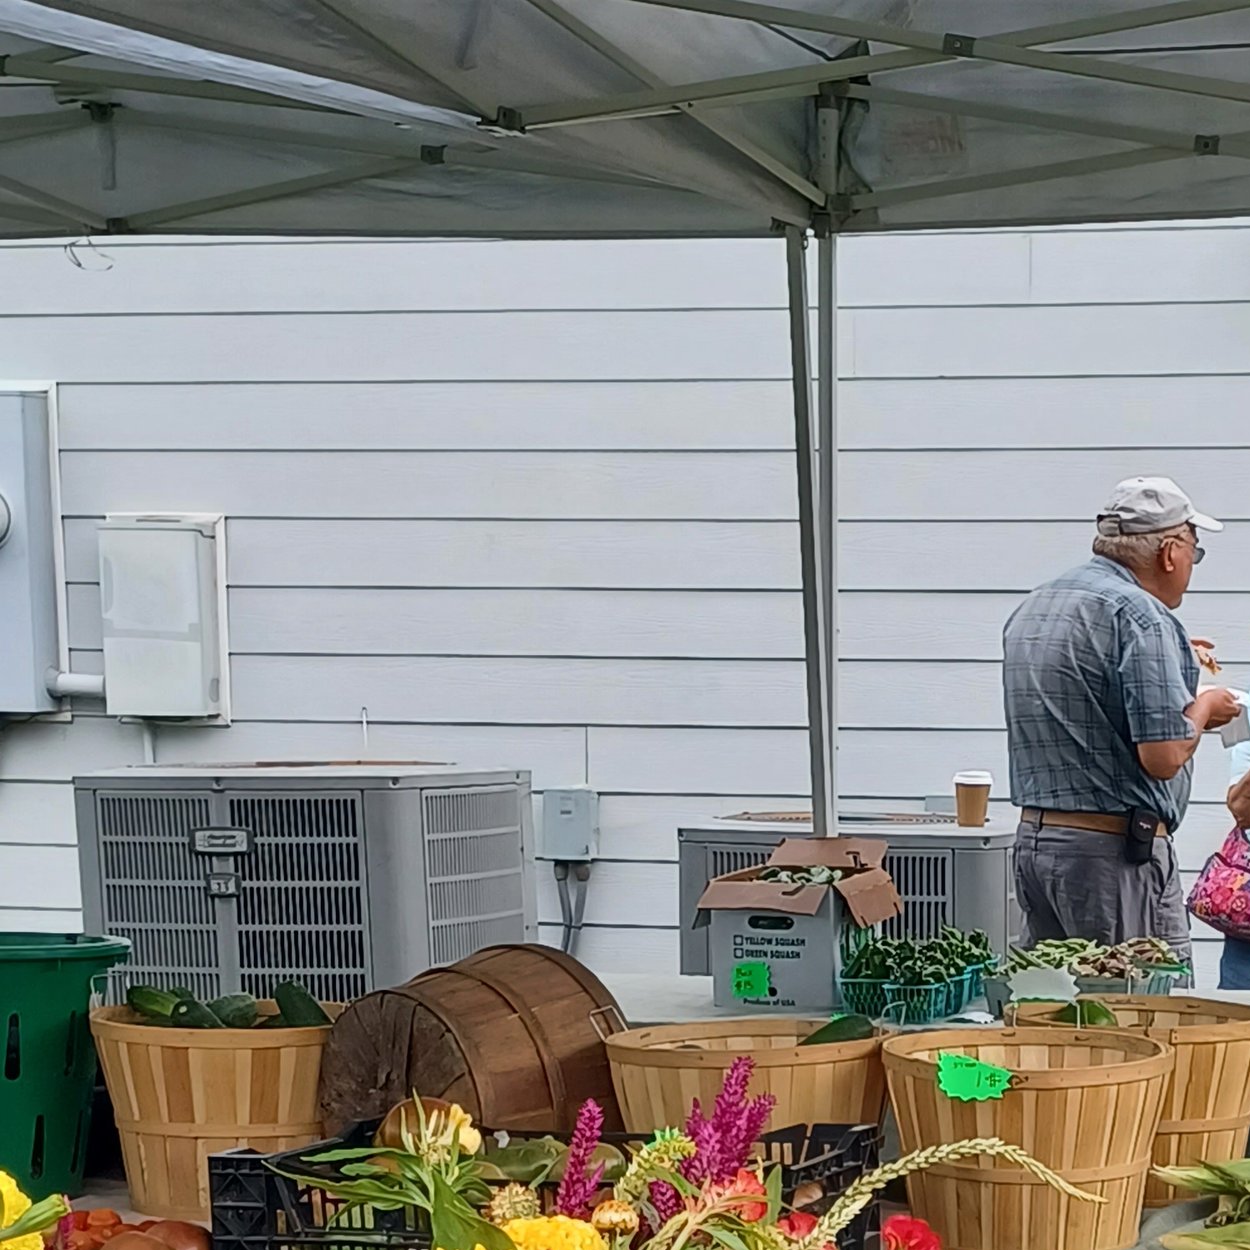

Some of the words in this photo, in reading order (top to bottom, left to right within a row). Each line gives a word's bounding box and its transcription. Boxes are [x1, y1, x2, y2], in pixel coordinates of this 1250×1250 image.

[745, 936, 773, 946] YELLOW
[775, 937, 806, 947] SQUASH
[745, 949, 768, 958] GREEN
[770, 950, 801, 959] SQUASH
